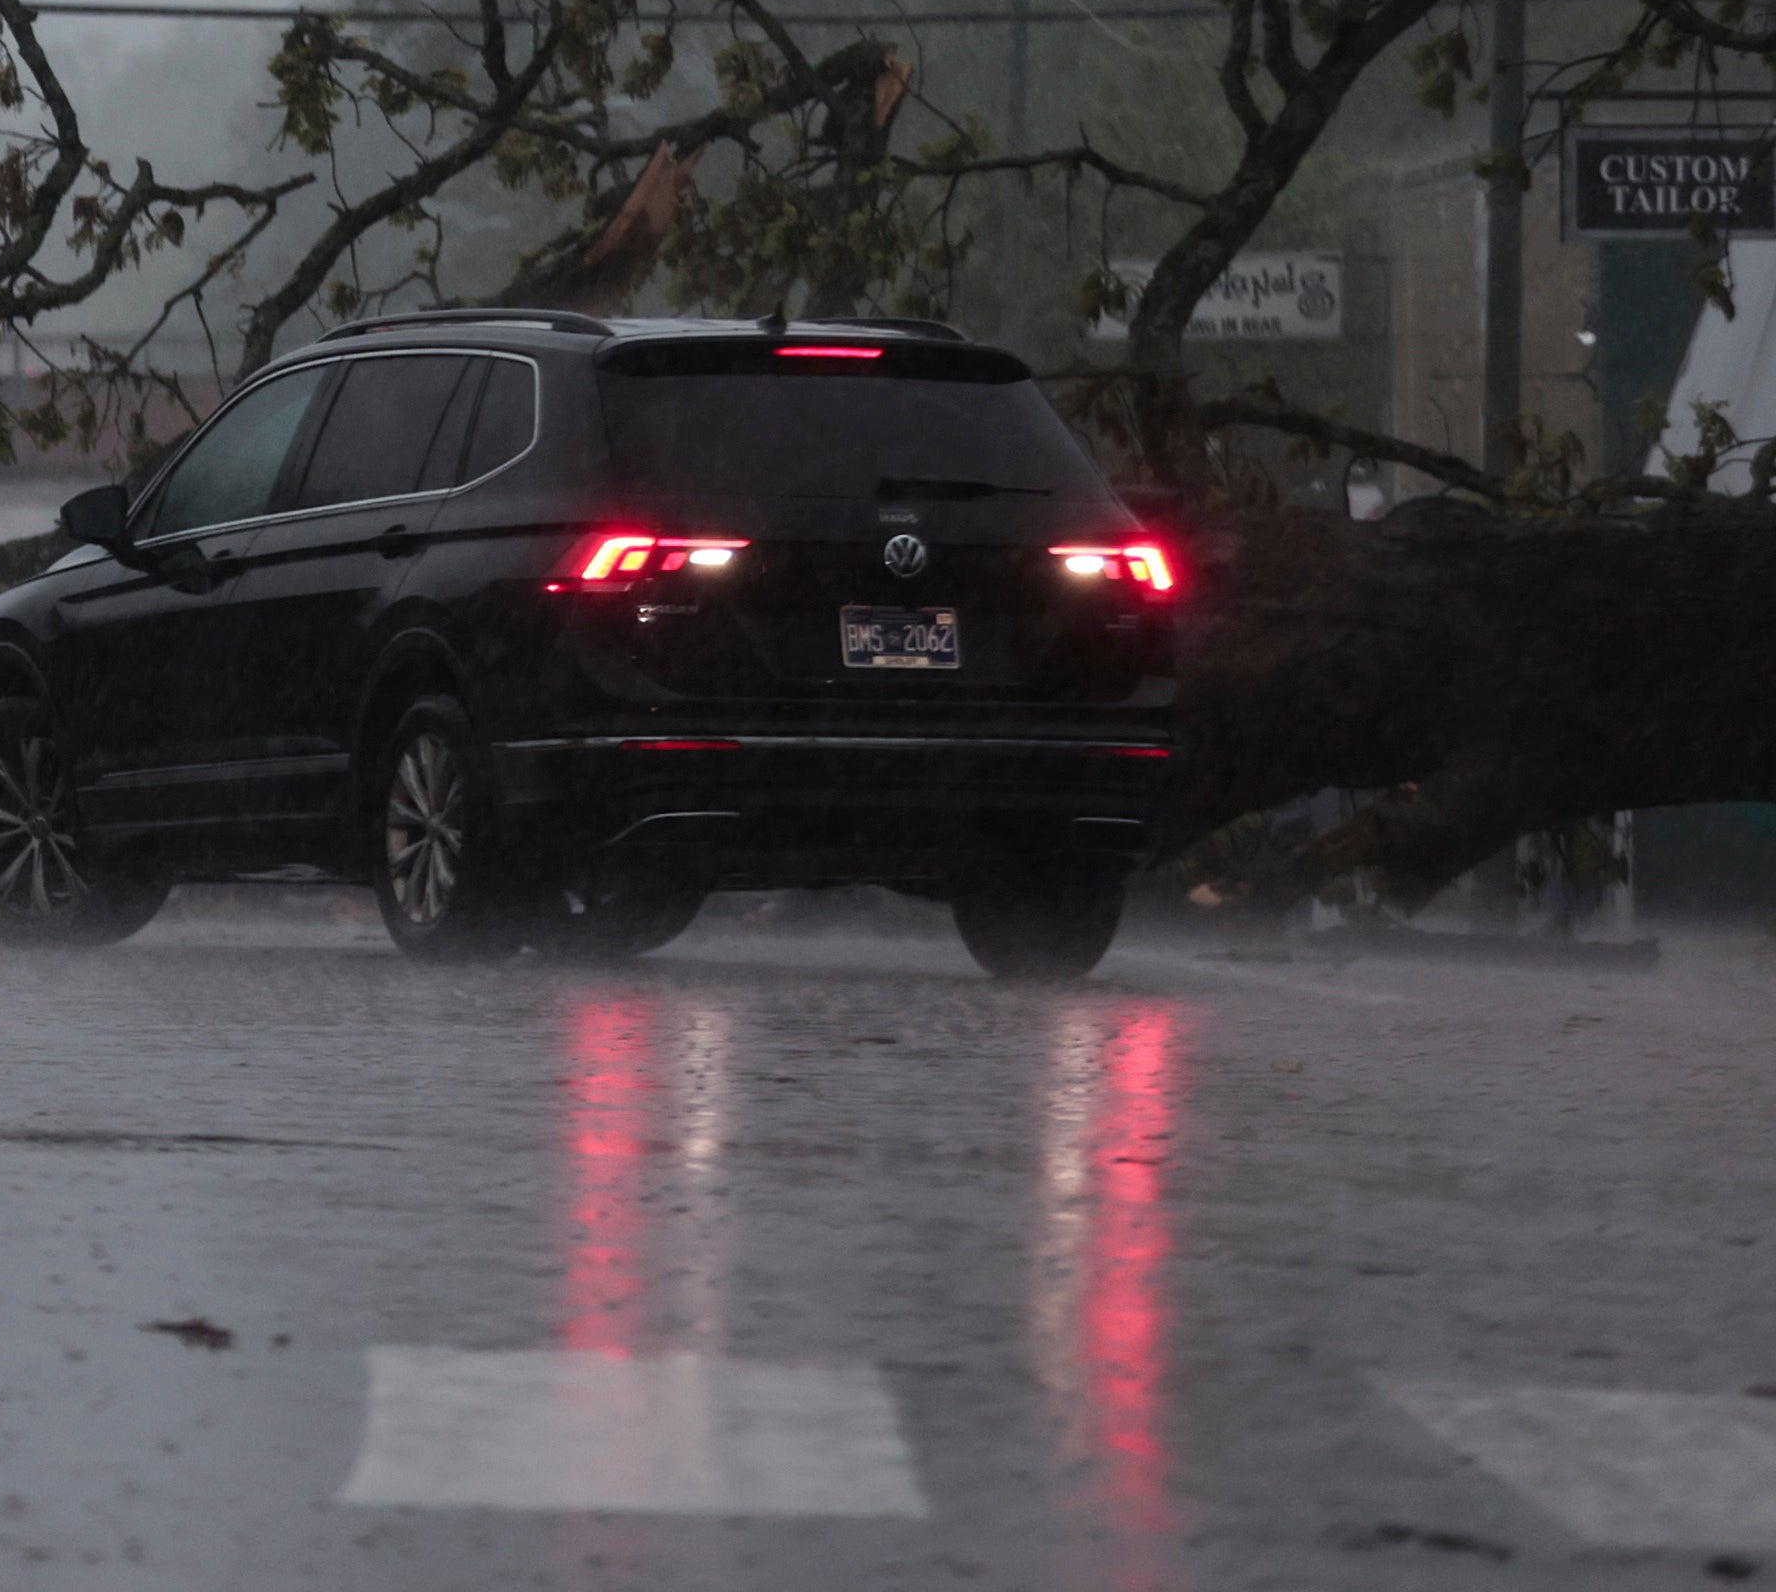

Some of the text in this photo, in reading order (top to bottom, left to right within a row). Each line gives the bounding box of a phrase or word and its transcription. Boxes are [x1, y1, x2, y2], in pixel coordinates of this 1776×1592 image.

[1598, 154, 1751, 184] CUSTOM
[1607, 185, 1744, 215] TAILOR
[1220, 315, 1237, 336] IN
[1241, 315, 1281, 336] REAR
[846, 624, 954, 652] BMS 2062
